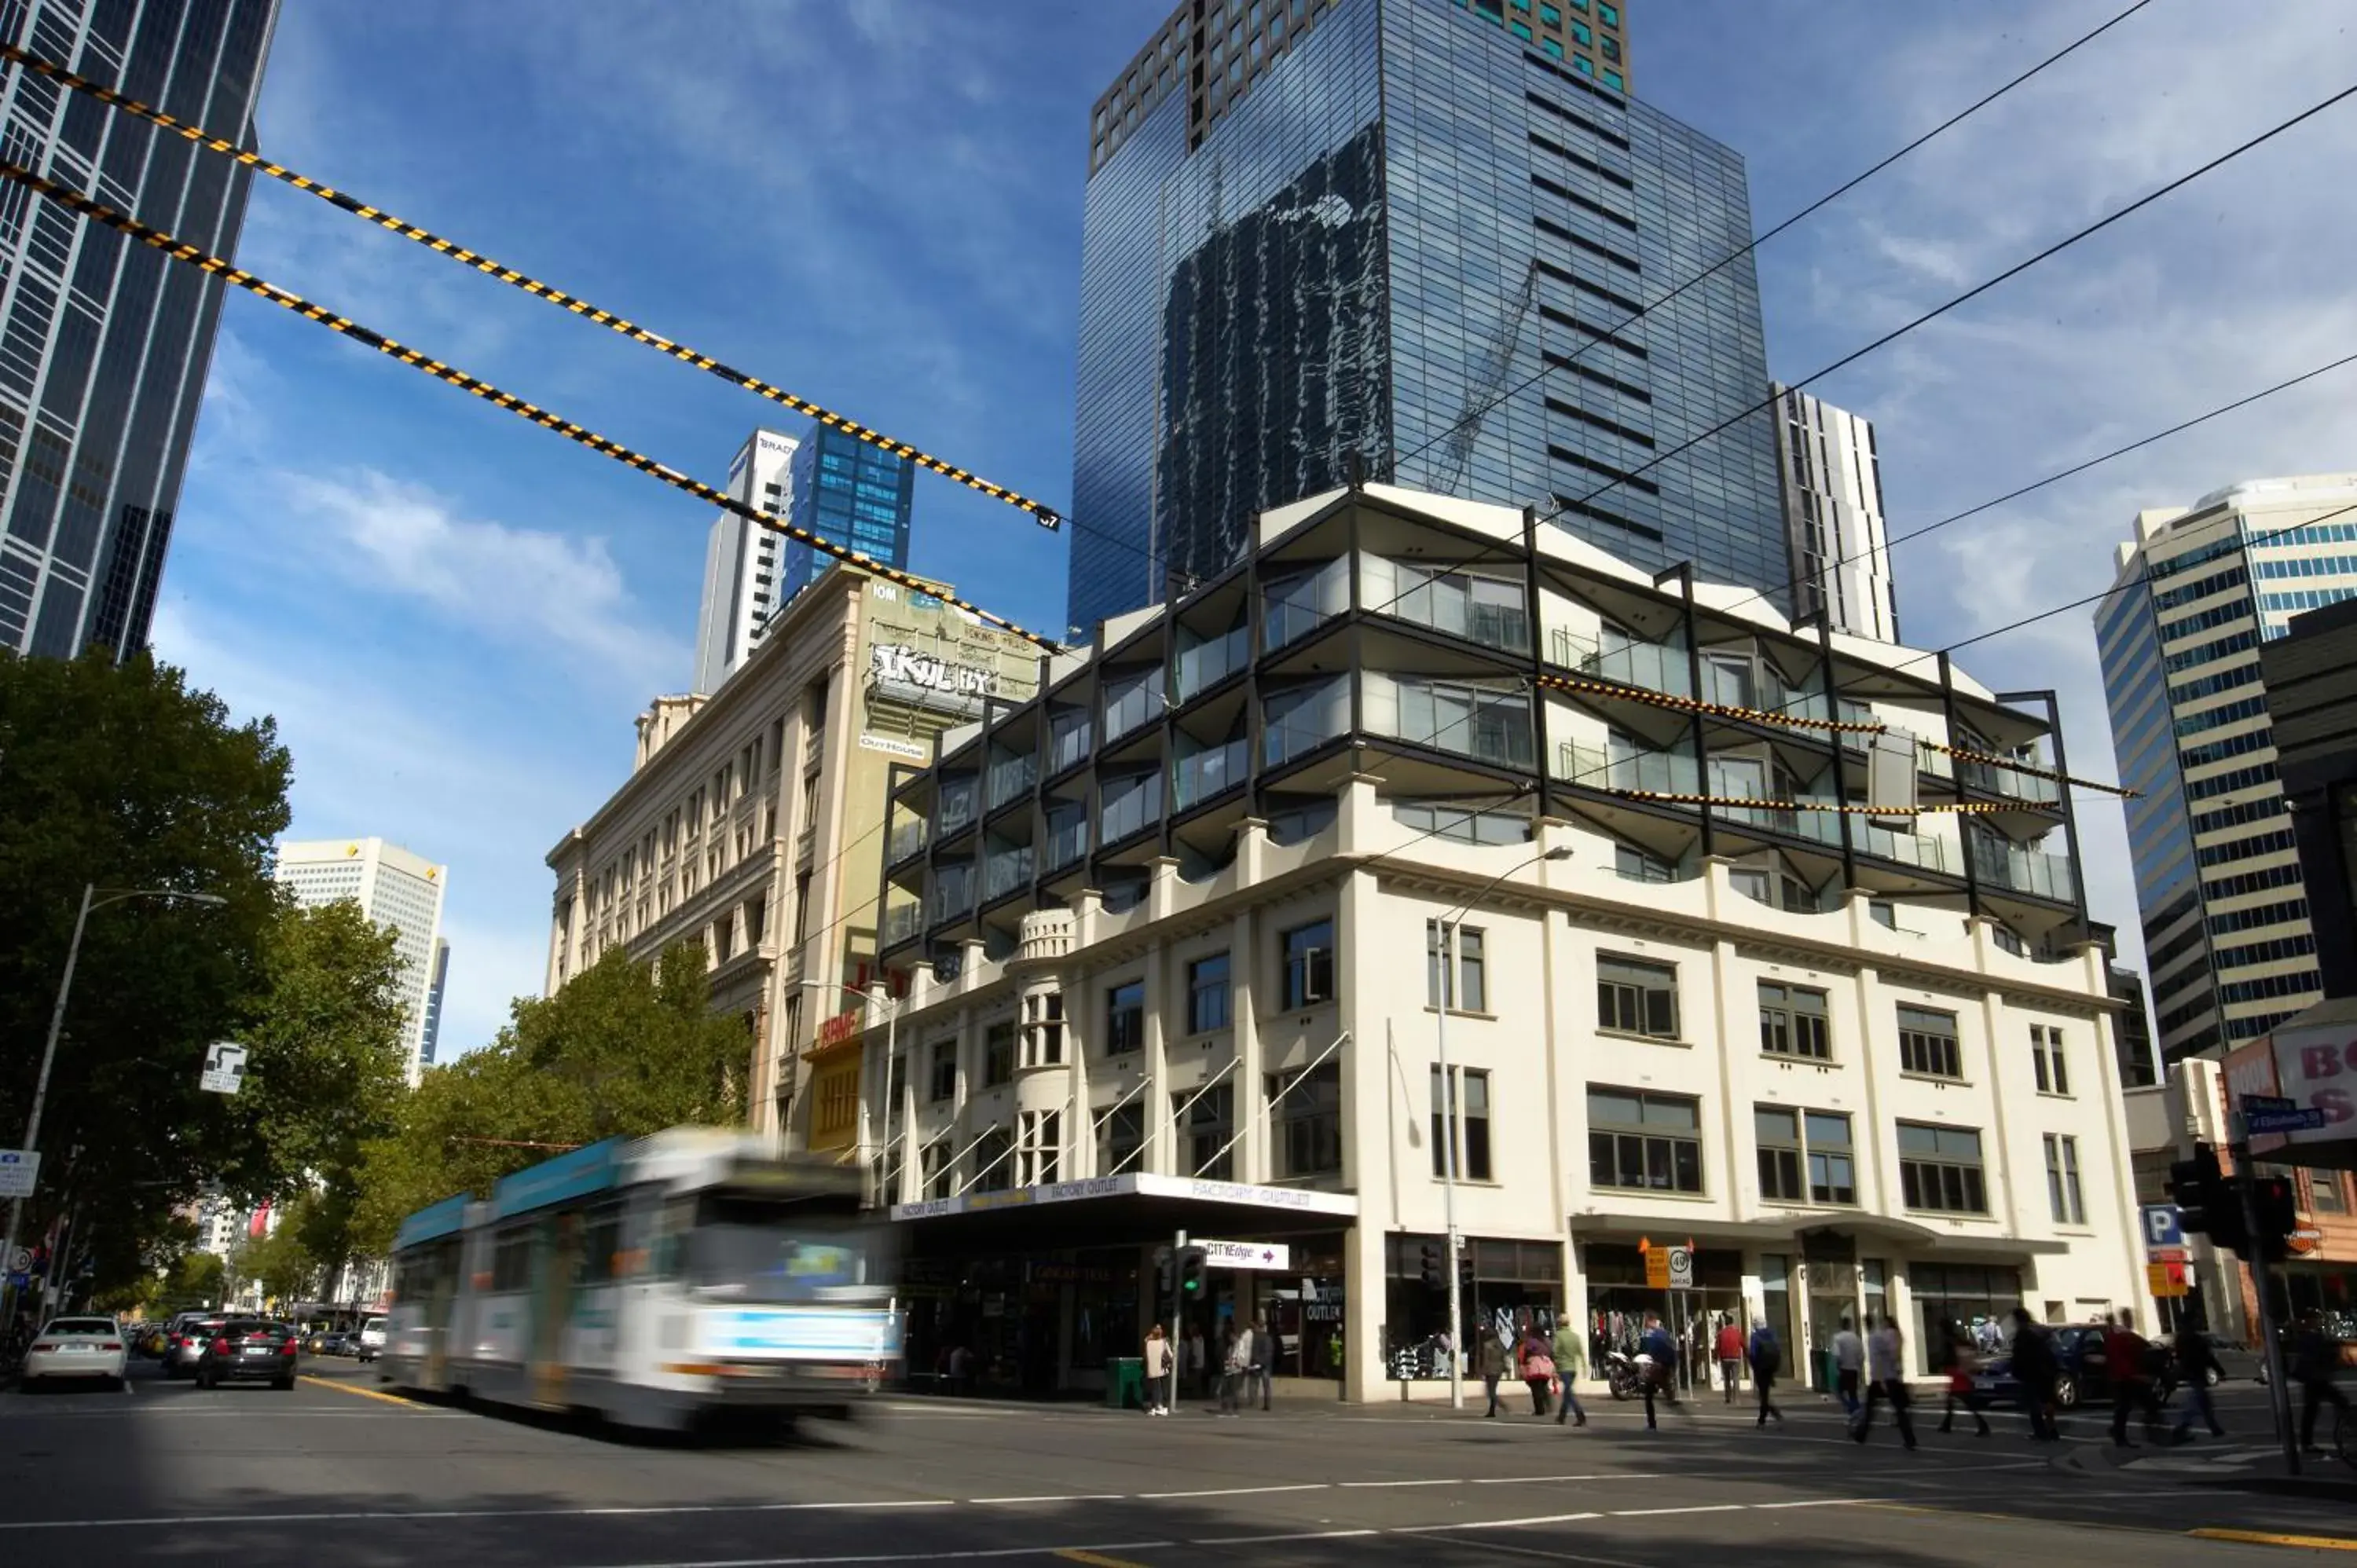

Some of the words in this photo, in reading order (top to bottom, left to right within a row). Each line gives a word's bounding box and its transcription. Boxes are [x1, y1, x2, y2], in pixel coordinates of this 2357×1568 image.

[760, 438, 794, 455] BRAD
[1051, 1181, 1085, 1199] FACTORY
[1088, 1178, 1119, 1195] OUTLET
[1191, 1182, 1255, 1202] FACTORY
[1259, 1189, 1311, 1207] OUTLET
[2148, 1210, 2172, 1242] P
